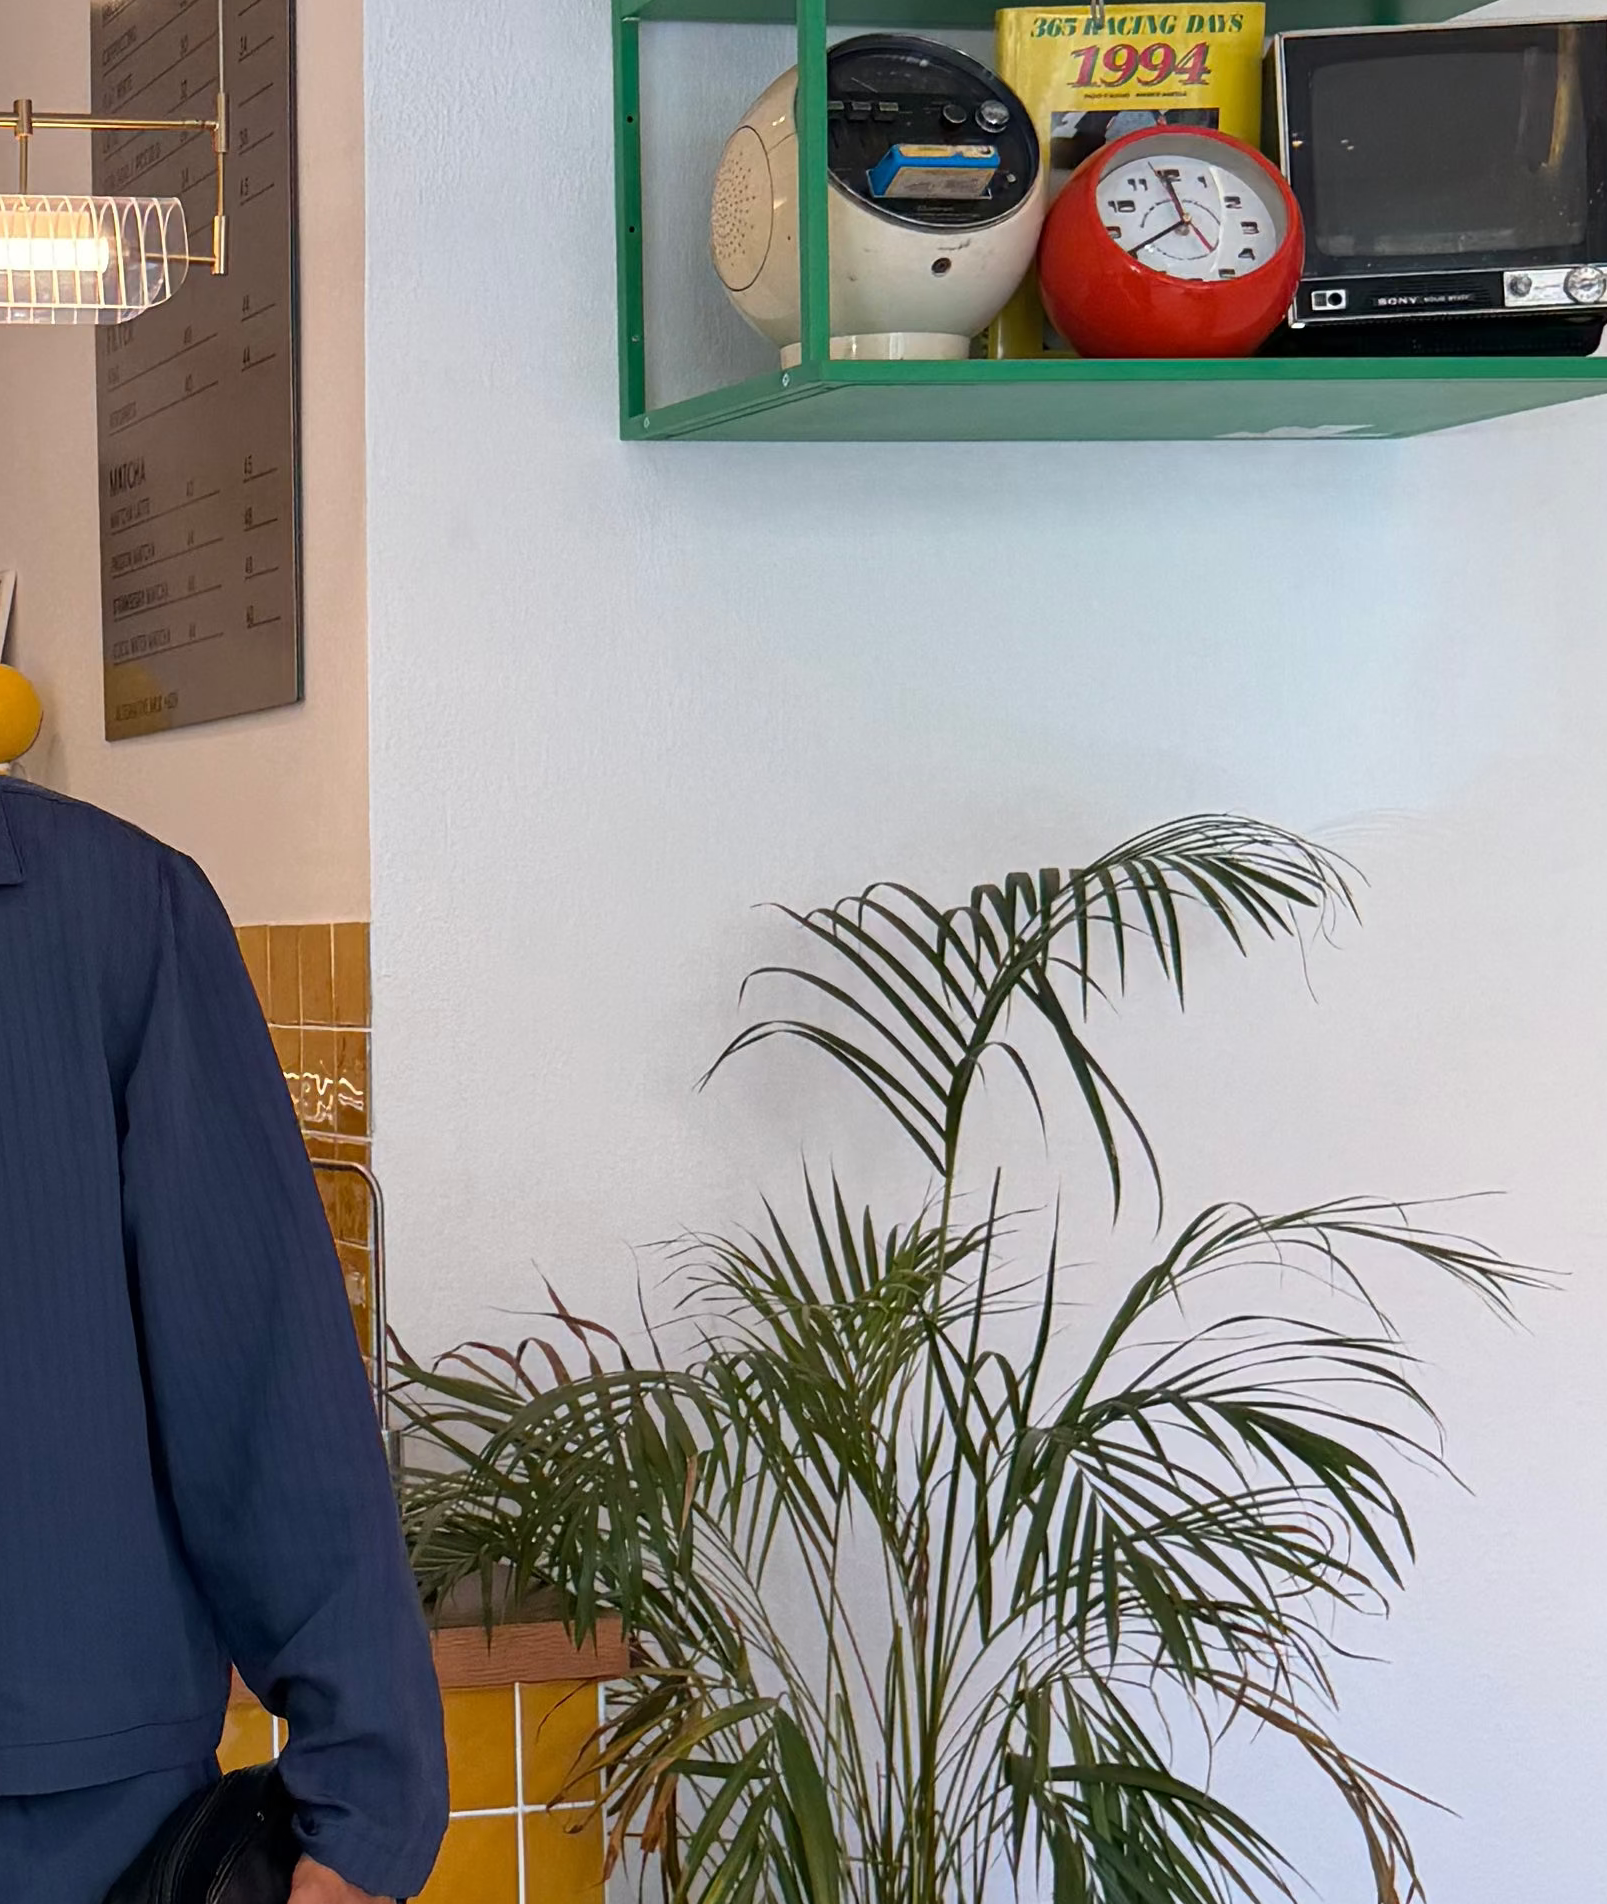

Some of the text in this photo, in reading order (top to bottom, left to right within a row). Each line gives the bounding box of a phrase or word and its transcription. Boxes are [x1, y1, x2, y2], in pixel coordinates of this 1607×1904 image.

[1030, 13, 1244, 38] 365 RACING DAYS
[1066, 41, 1212, 88] 1994
[1377, 295, 1418, 307] SONY
[109, 457, 146, 498] MATCHA
